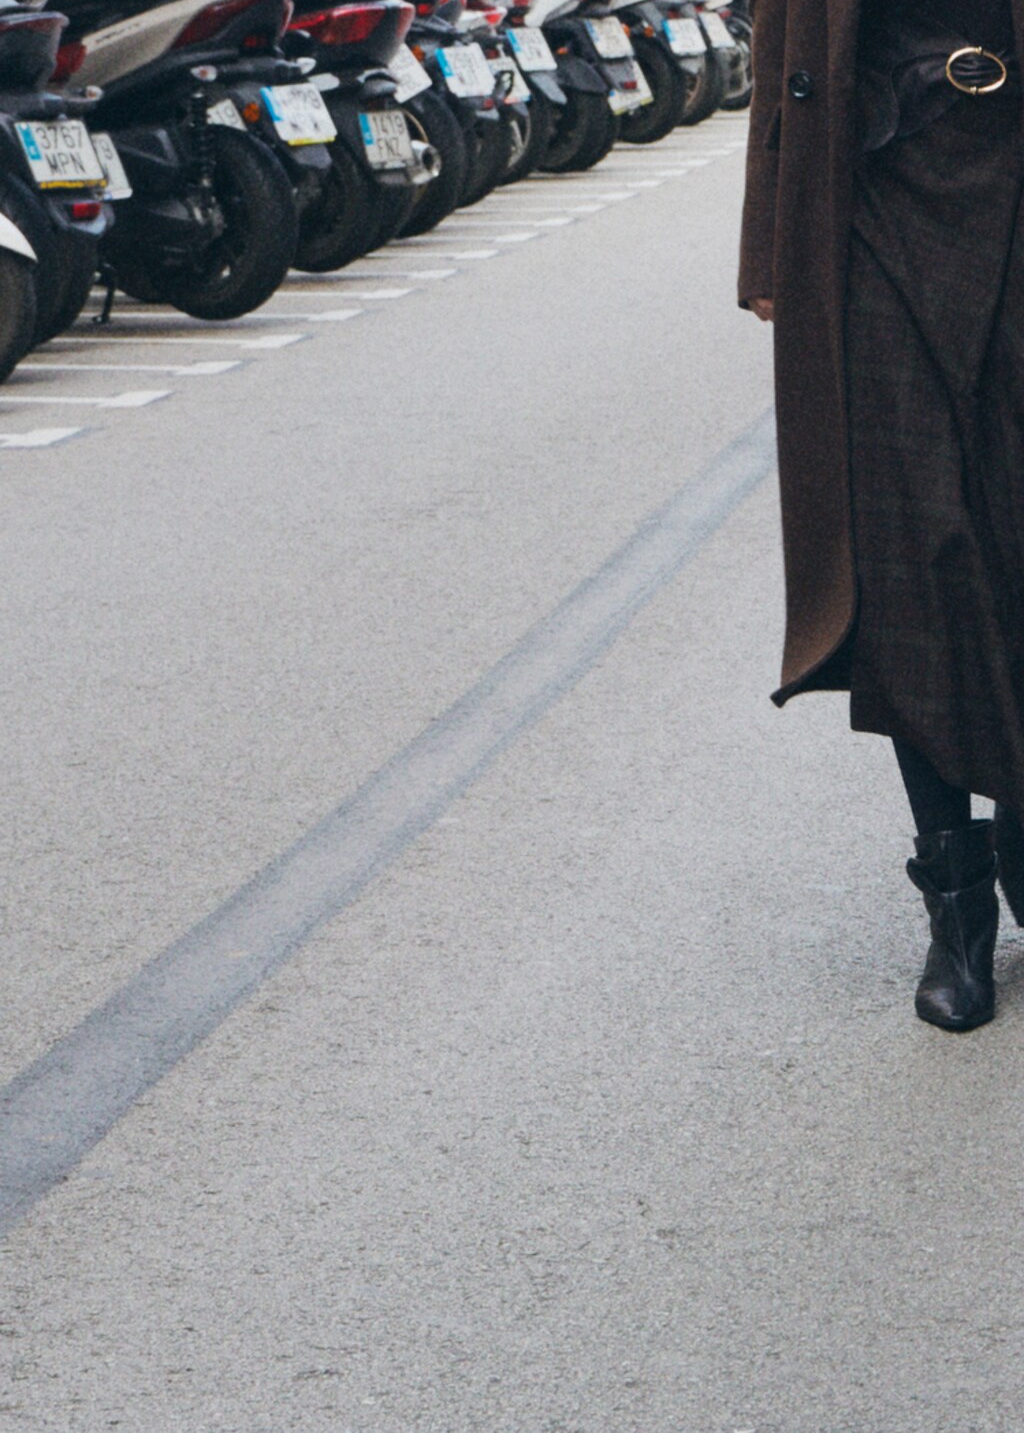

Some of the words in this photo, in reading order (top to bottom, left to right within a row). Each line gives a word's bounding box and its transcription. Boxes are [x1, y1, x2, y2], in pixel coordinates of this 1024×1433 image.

[372, 114, 405, 135] 1419
[36, 126, 83, 150] 3767
[45, 152, 87, 175] MPN
